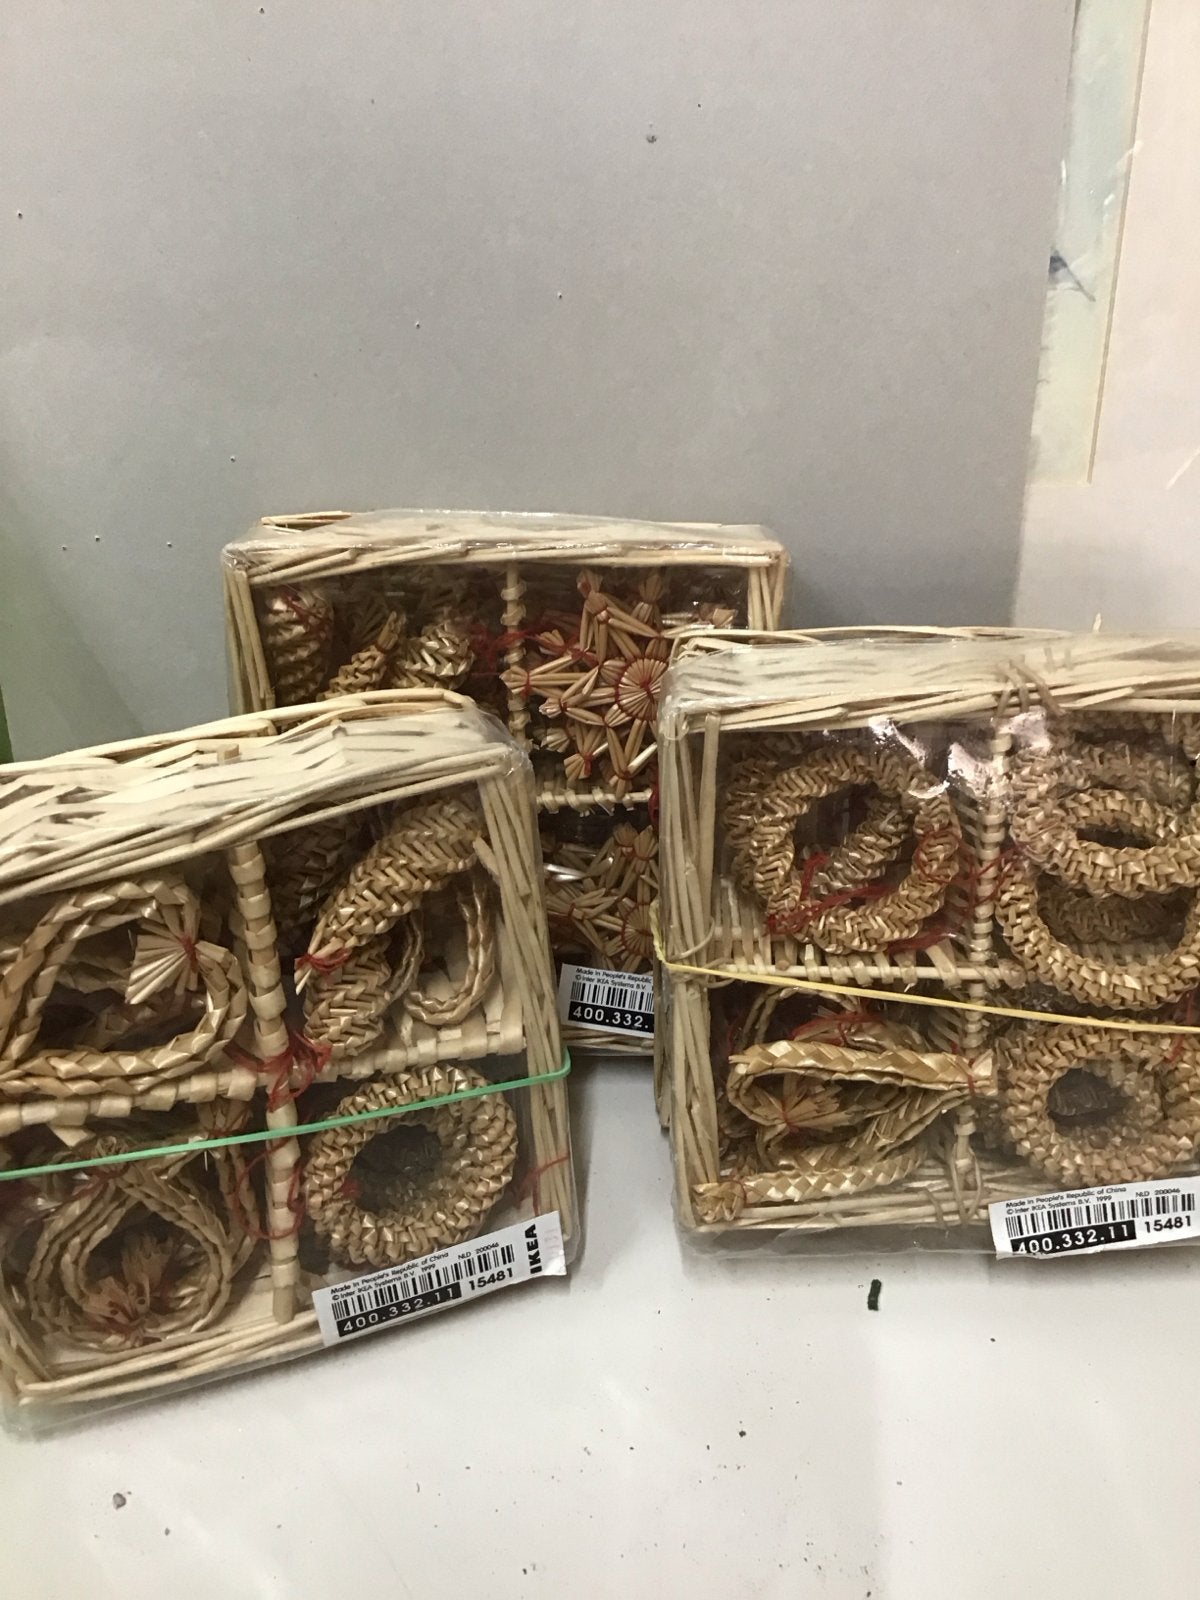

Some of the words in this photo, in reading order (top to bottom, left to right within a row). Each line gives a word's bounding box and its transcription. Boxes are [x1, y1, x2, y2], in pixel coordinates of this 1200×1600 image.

[573, 1006, 649, 1029] 400.332.
[1036, 1194, 1064, 1204] People's
[1066, 1191, 1095, 1200] Republic
[1048, 1200, 1076, 1209] Systems
[1144, 1216, 1192, 1233] 15481
[524, 1224, 542, 1274] IKEA
[1017, 1224, 1129, 1254] 400.332.11
[330, 1284, 351, 1294] Made
[361, 1272, 390, 1285] People's
[391, 1263, 419, 1276] Republic
[430, 1252, 449, 1262] China
[375, 1276, 402, 1288] Systems
[421, 1264, 436, 1272] 1999
[468, 1268, 513, 1291] 15481
[343, 1287, 455, 1332] 400.332.11
